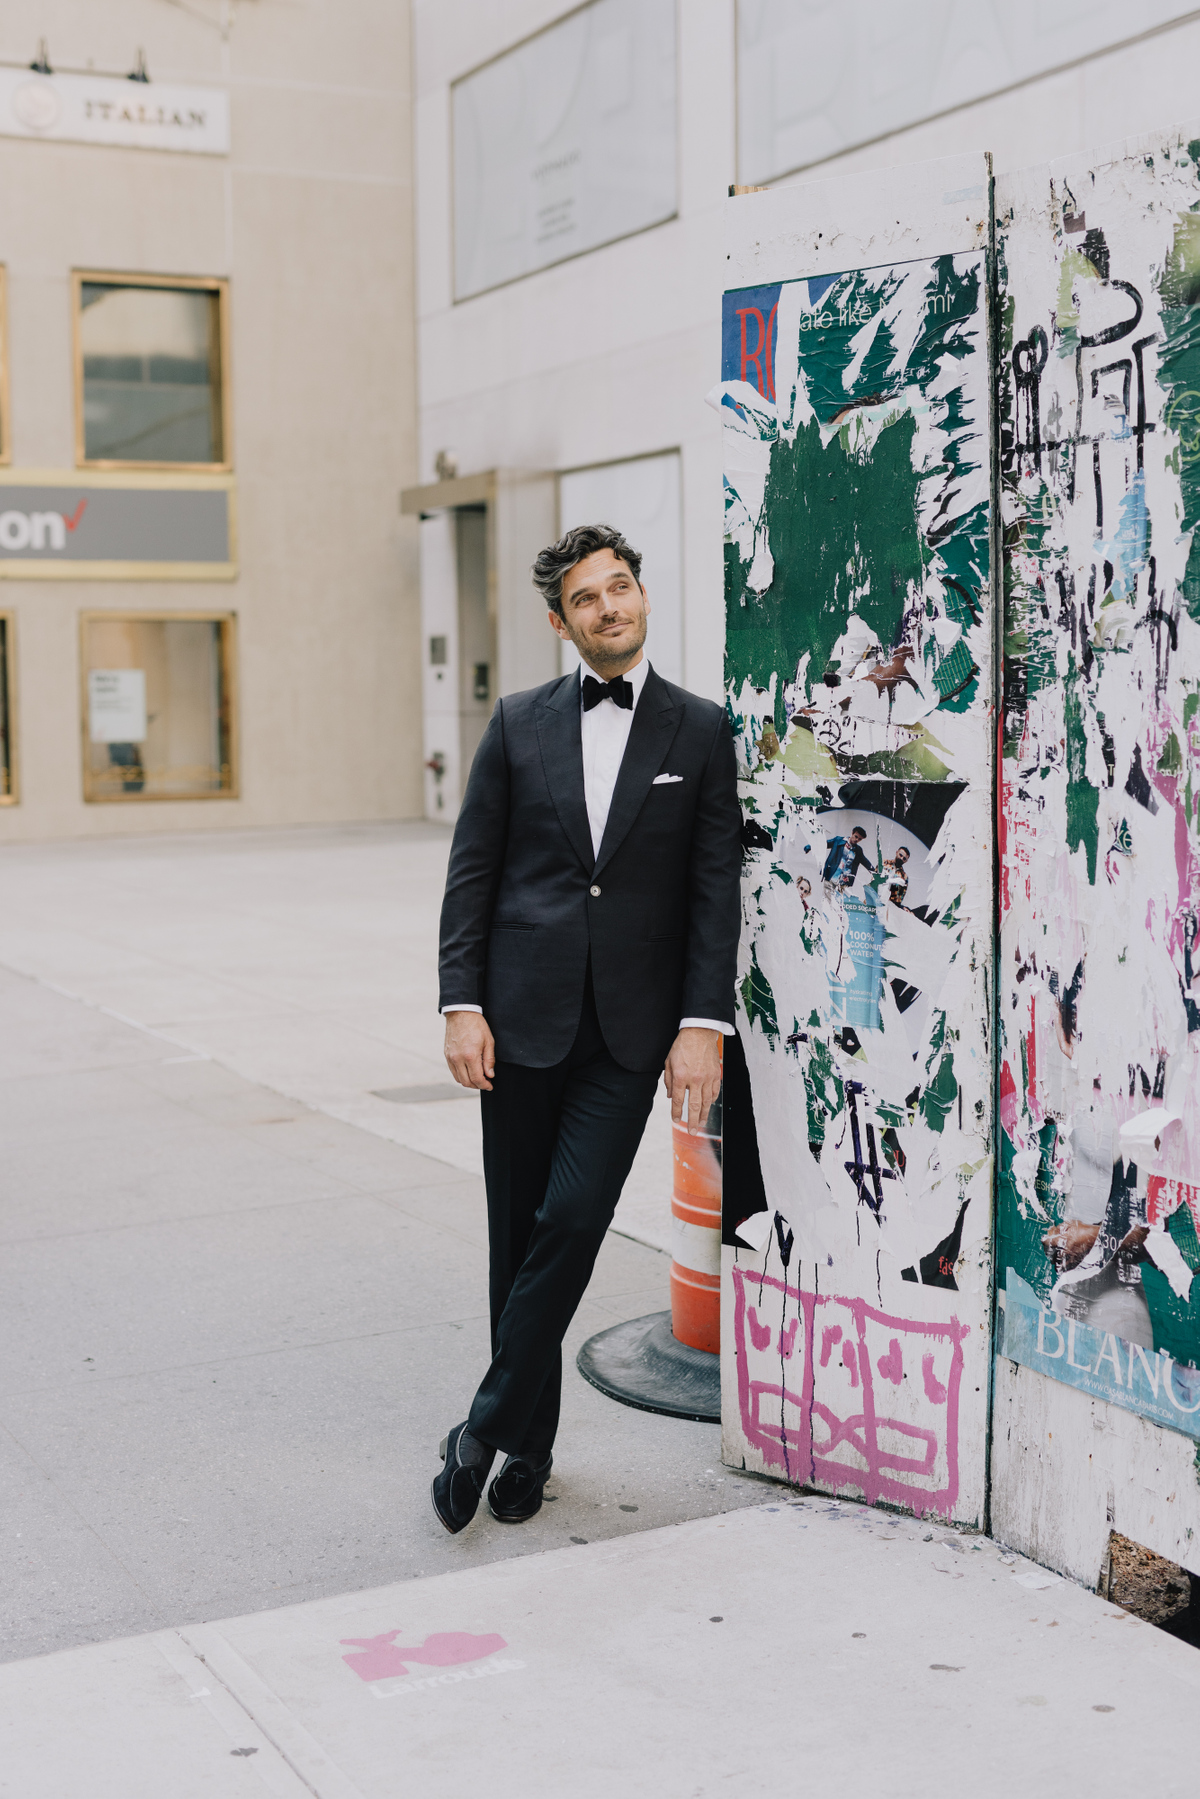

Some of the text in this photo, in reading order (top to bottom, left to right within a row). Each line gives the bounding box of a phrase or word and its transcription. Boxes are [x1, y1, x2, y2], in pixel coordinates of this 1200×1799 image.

[84, 100, 206, 126] ITALIAN
[0, 510, 66, 551] on
[849, 931, 875, 942] 100%
[850, 941, 882, 951] COCONUT
[850, 949, 874, 958] WATER
